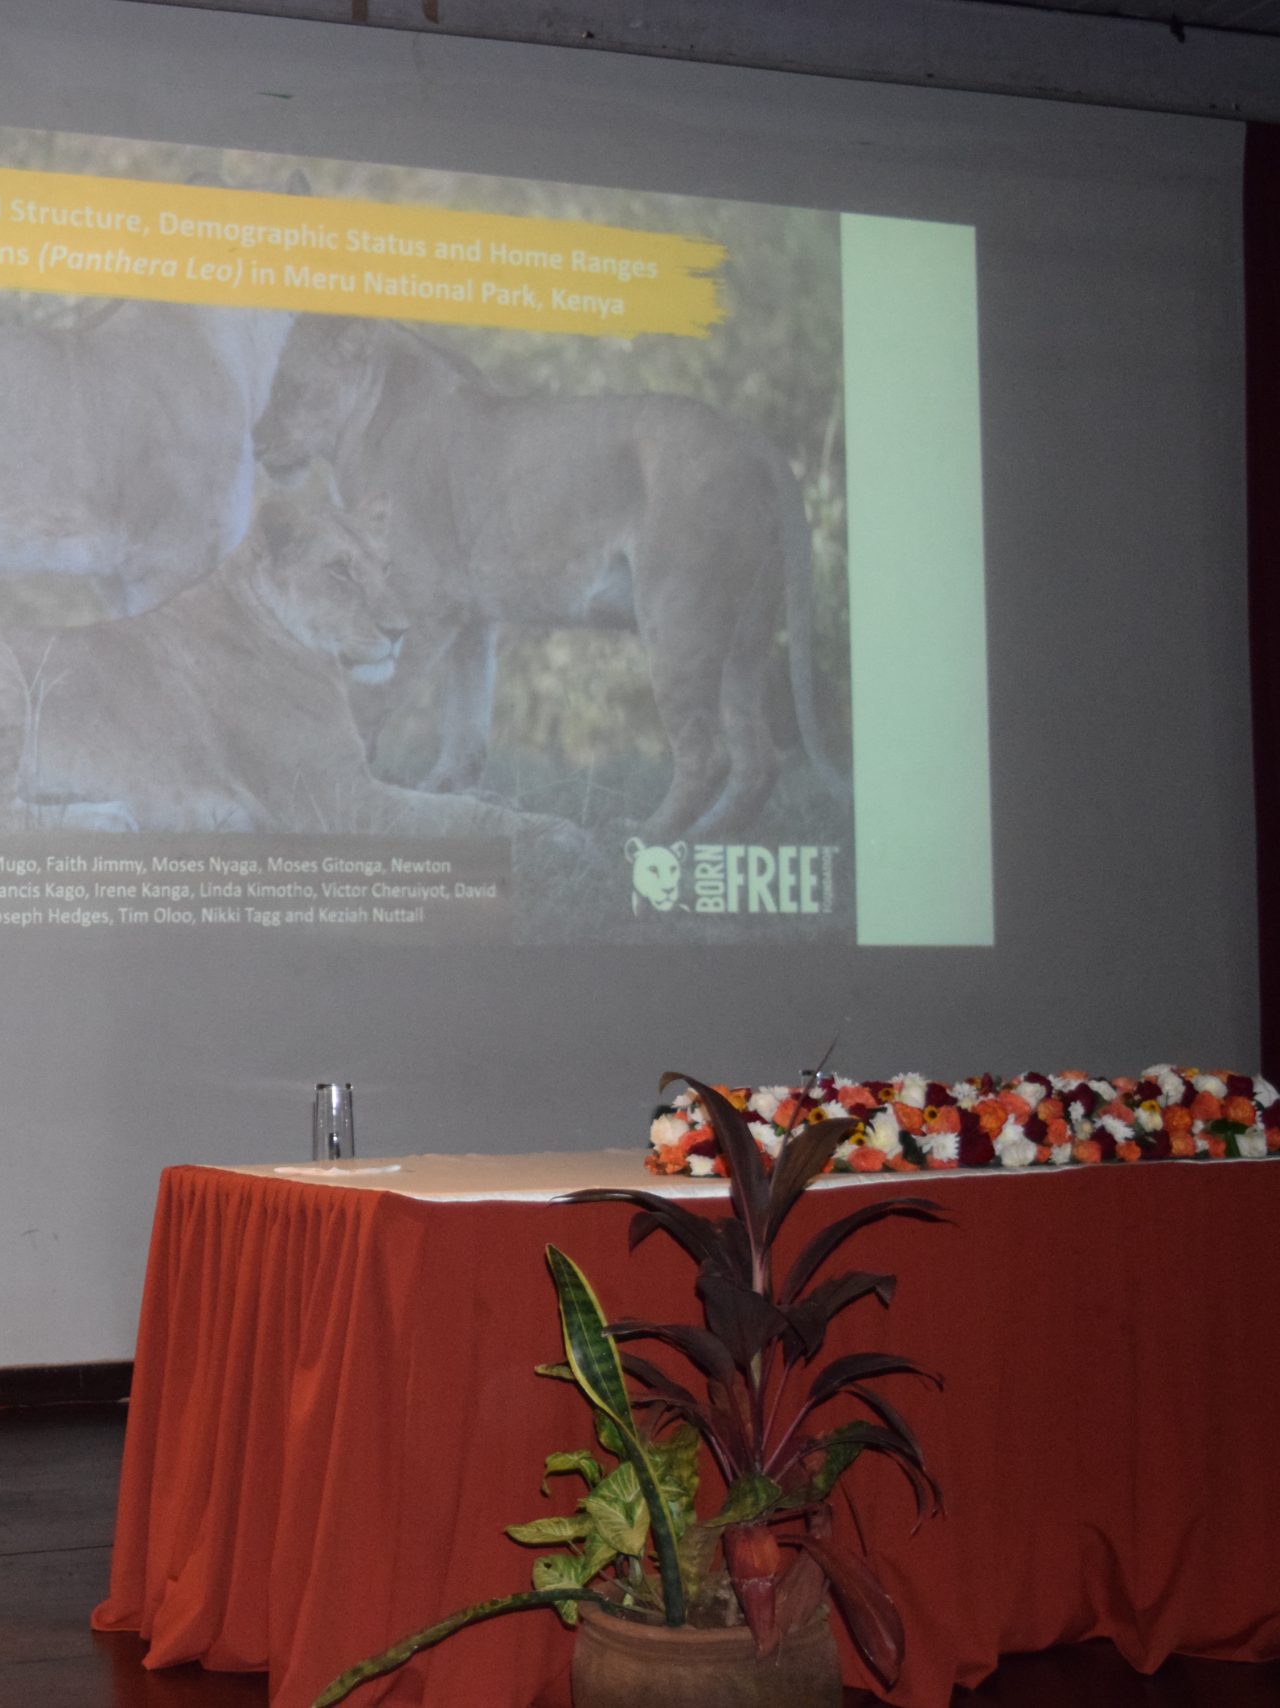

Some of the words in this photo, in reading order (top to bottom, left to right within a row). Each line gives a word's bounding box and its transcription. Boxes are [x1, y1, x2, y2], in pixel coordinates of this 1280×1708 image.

[10, 198, 150, 237] Structure,
[159, 212, 339, 251] Demographic
[346, 228, 427, 258] Status
[434, 239, 482, 263] and
[490, 242, 564, 271] Home
[572, 250, 658, 282] Ranges
[39, 241, 178, 278] (Panthera
[186, 255, 244, 289] Leo)
[250, 260, 276, 286] in
[284, 264, 357, 293] Meru
[364, 271, 474, 302] National
[481, 281, 544, 312] Park,
[551, 288, 626, 320] Kenya
[45, 882, 89, 902] Kago,
[95, 882, 136, 899] Irene
[142, 882, 195, 902] Kanga,
[200, 881, 242, 898] Linda
[247, 881, 317, 901] Kimotho,
[322, 882, 368, 898] Victor
[371, 881, 450, 901] Cheruiyot,
[455, 882, 497, 898] David
[47, 856, 87, 873] Faith
[92, 856, 147, 876] Jimmy,
[152, 856, 205, 873] Moses
[209, 856, 262, 876] Nyaga,
[268, 856, 318, 873] Moses
[322, 856, 386, 877] Gitonga,
[391, 857, 451, 874] Newton
[694, 844, 725, 913] BORN
[726, 845, 819, 913] FREE
[48, 907, 114, 927] Hedges,
[118, 907, 149, 924] Tim
[154, 907, 197, 926] Oloo,
[201, 906, 241, 923] Nikki
[244, 906, 281, 927] Tagg
[285, 906, 314, 923] and
[319, 906, 368, 923] Keziah
[372, 906, 423, 923] Nuttall
